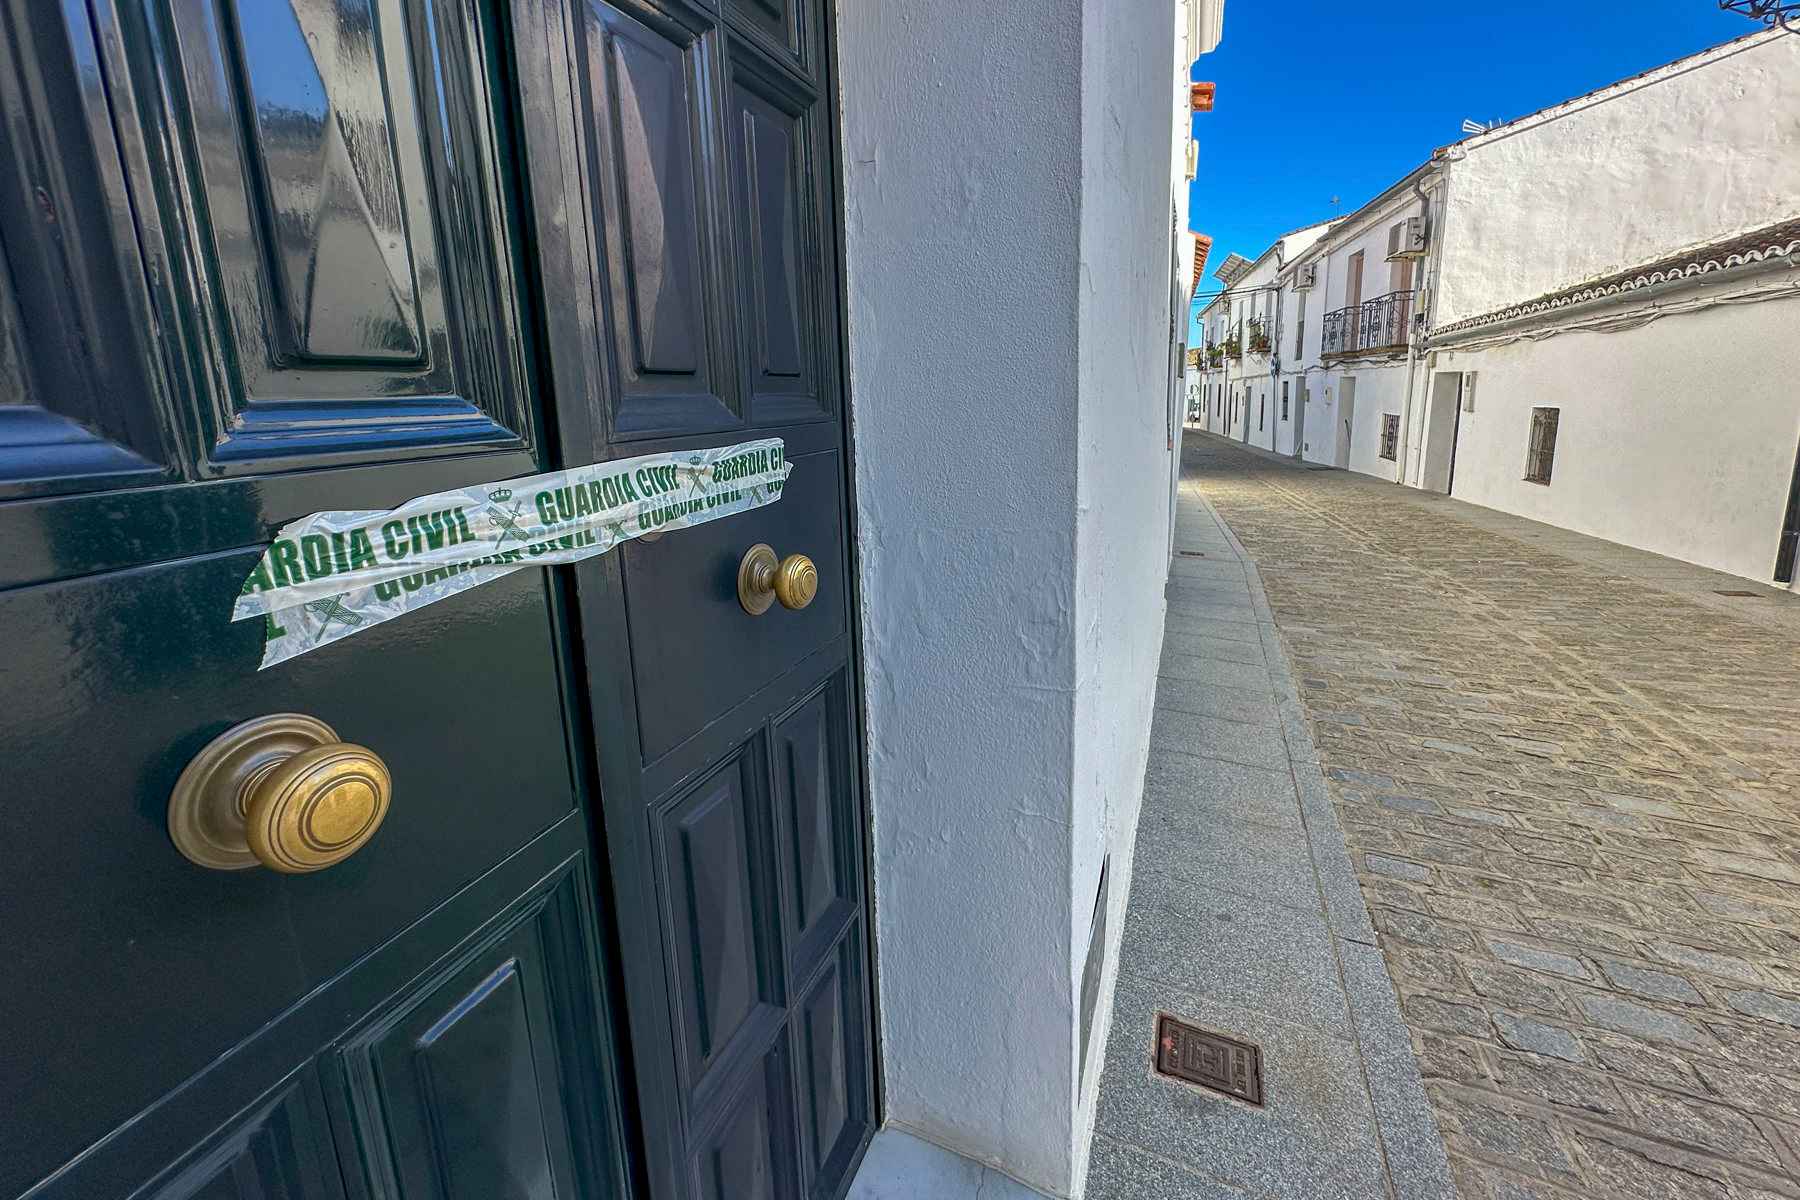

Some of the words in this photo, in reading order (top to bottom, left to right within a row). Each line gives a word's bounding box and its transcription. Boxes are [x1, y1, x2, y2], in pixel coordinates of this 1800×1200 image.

[382, 506, 476, 560] CIVIL
[534, 473, 640, 526] GUARDIA
[636, 463, 681, 498] CIVIL
[712, 449, 769, 483] GUARDIA
